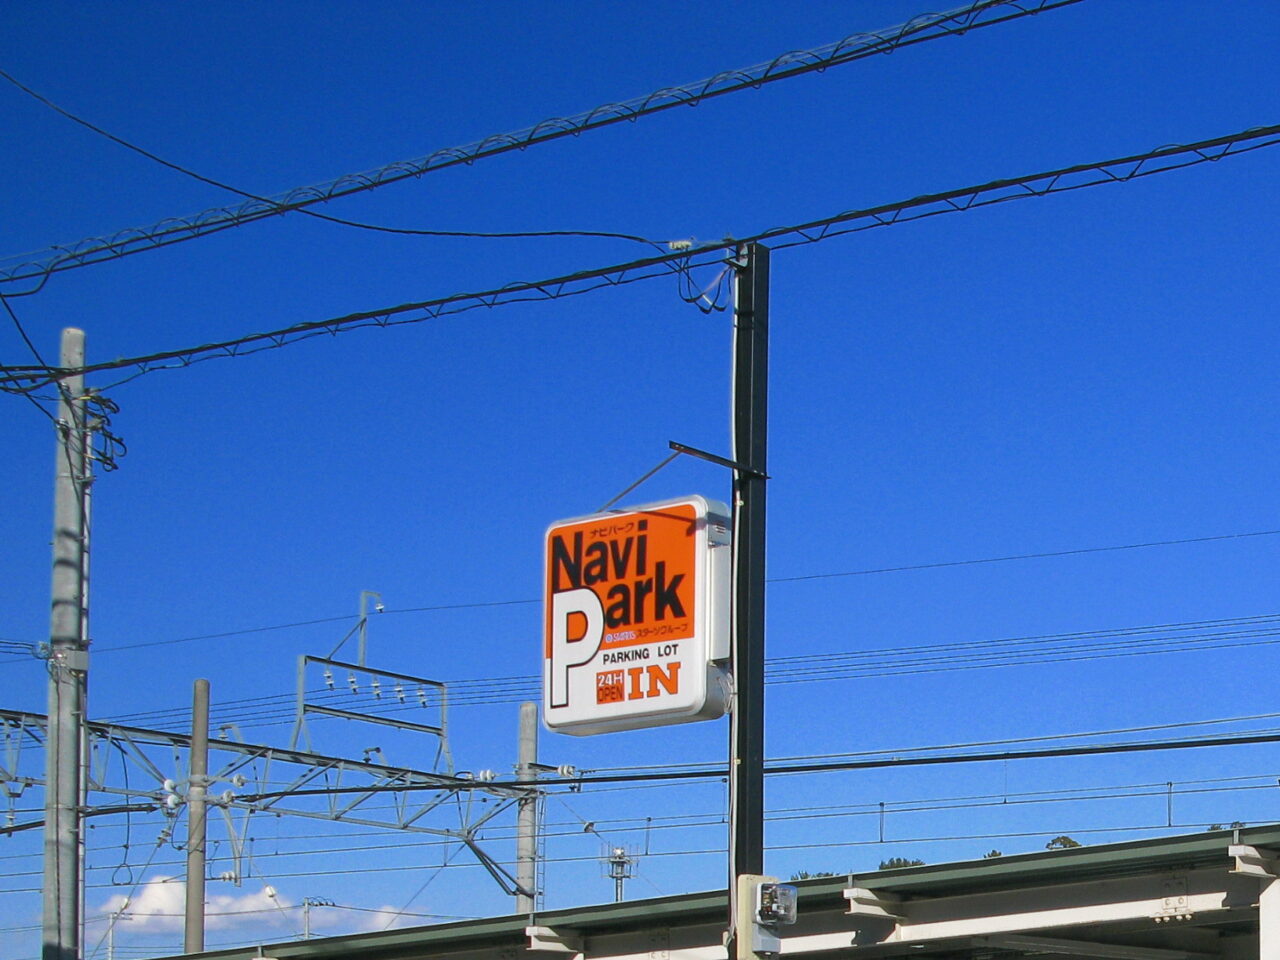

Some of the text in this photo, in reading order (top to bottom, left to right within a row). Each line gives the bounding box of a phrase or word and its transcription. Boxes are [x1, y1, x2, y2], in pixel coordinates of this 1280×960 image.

[552, 519, 648, 592] Navi
[550, 561, 686, 709] Park
[603, 644, 679, 665] PARKING LOT
[597, 685, 623, 702] OPEN
[598, 672, 623, 687] 24H
[628, 661, 681, 700] IN
